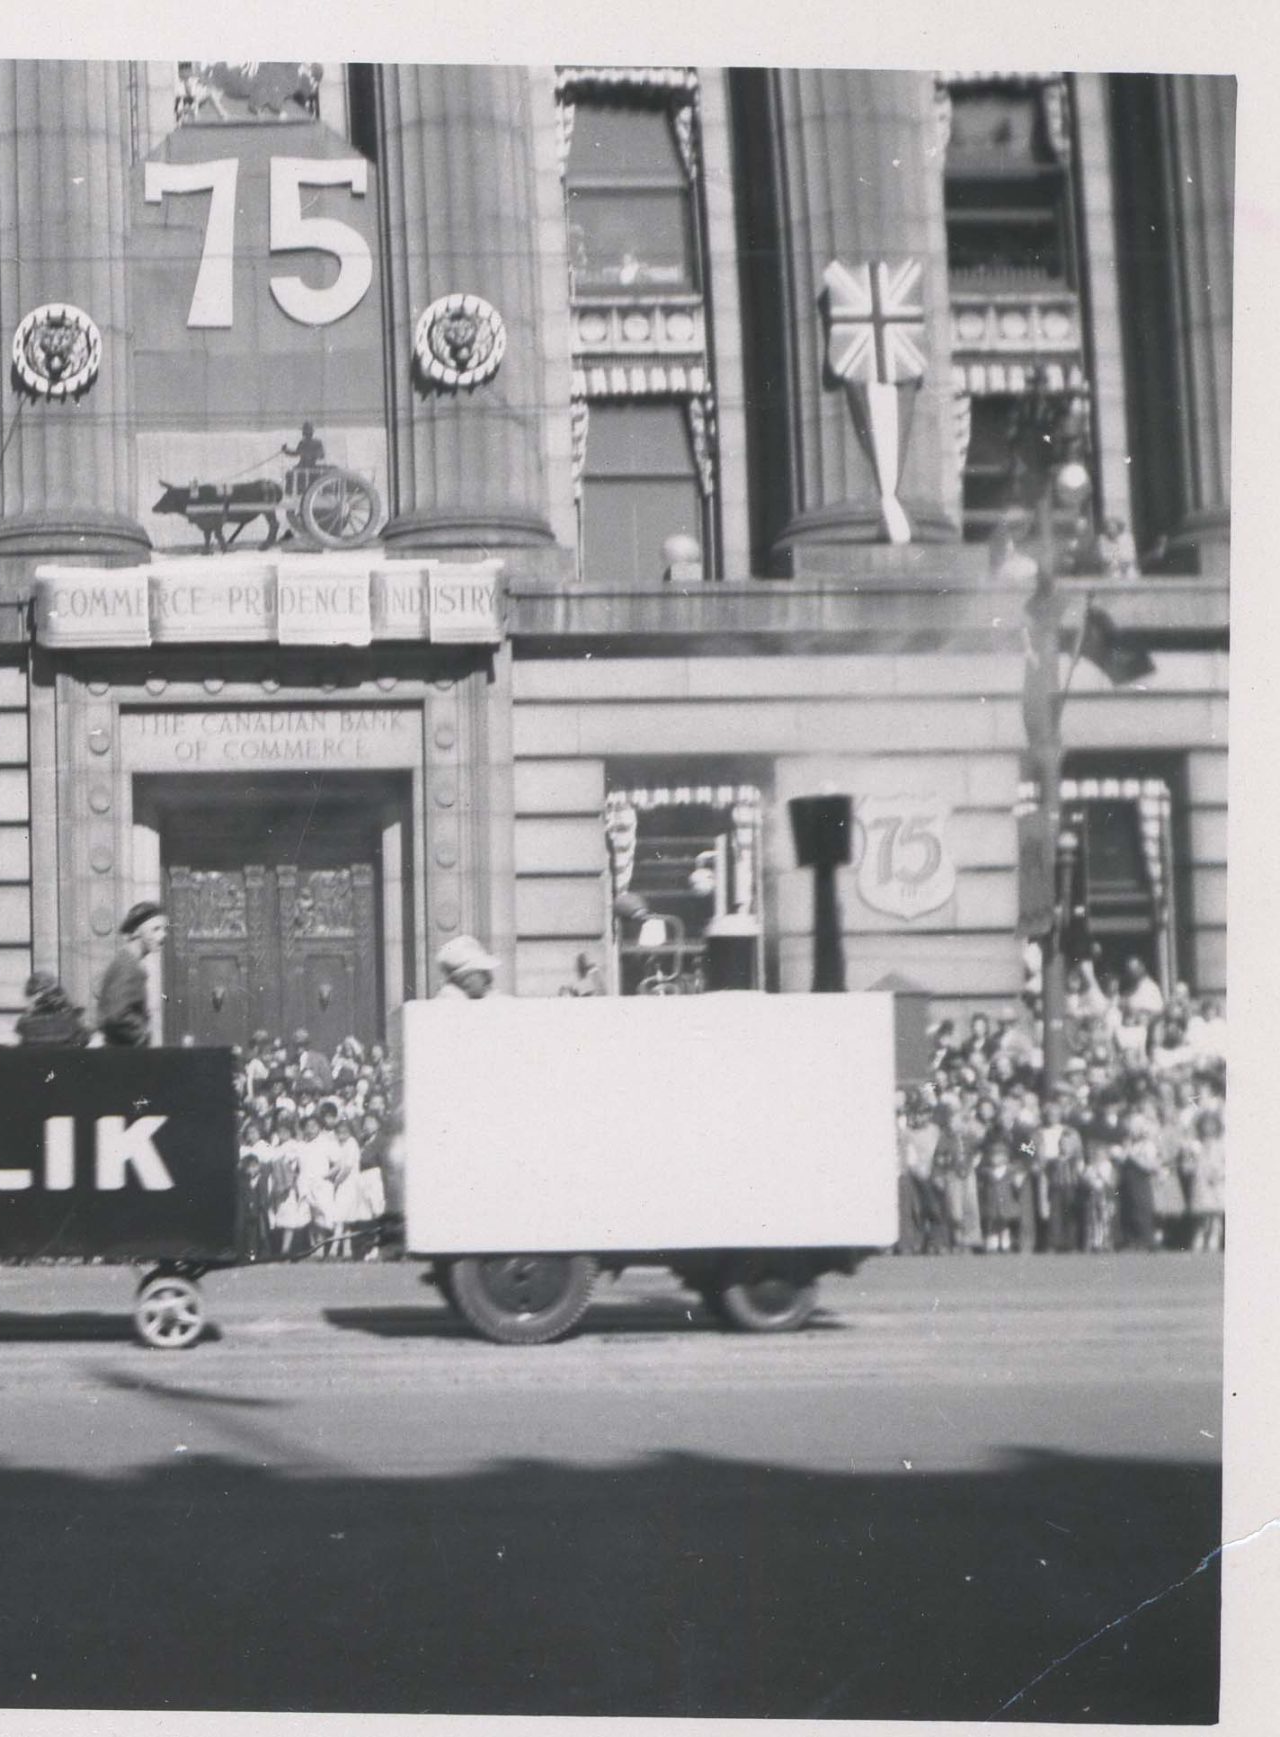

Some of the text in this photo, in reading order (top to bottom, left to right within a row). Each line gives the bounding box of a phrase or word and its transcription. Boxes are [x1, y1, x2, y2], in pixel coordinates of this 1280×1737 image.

[144, 156, 373, 329] 75
[54, 584, 496, 618] COMMERCE PRUDENCE INDUSTRY
[138, 709, 403, 736] THE CANADIAN BANK
[174, 737, 372, 762] OF COMMERCE
[866, 814, 942, 886] 75
